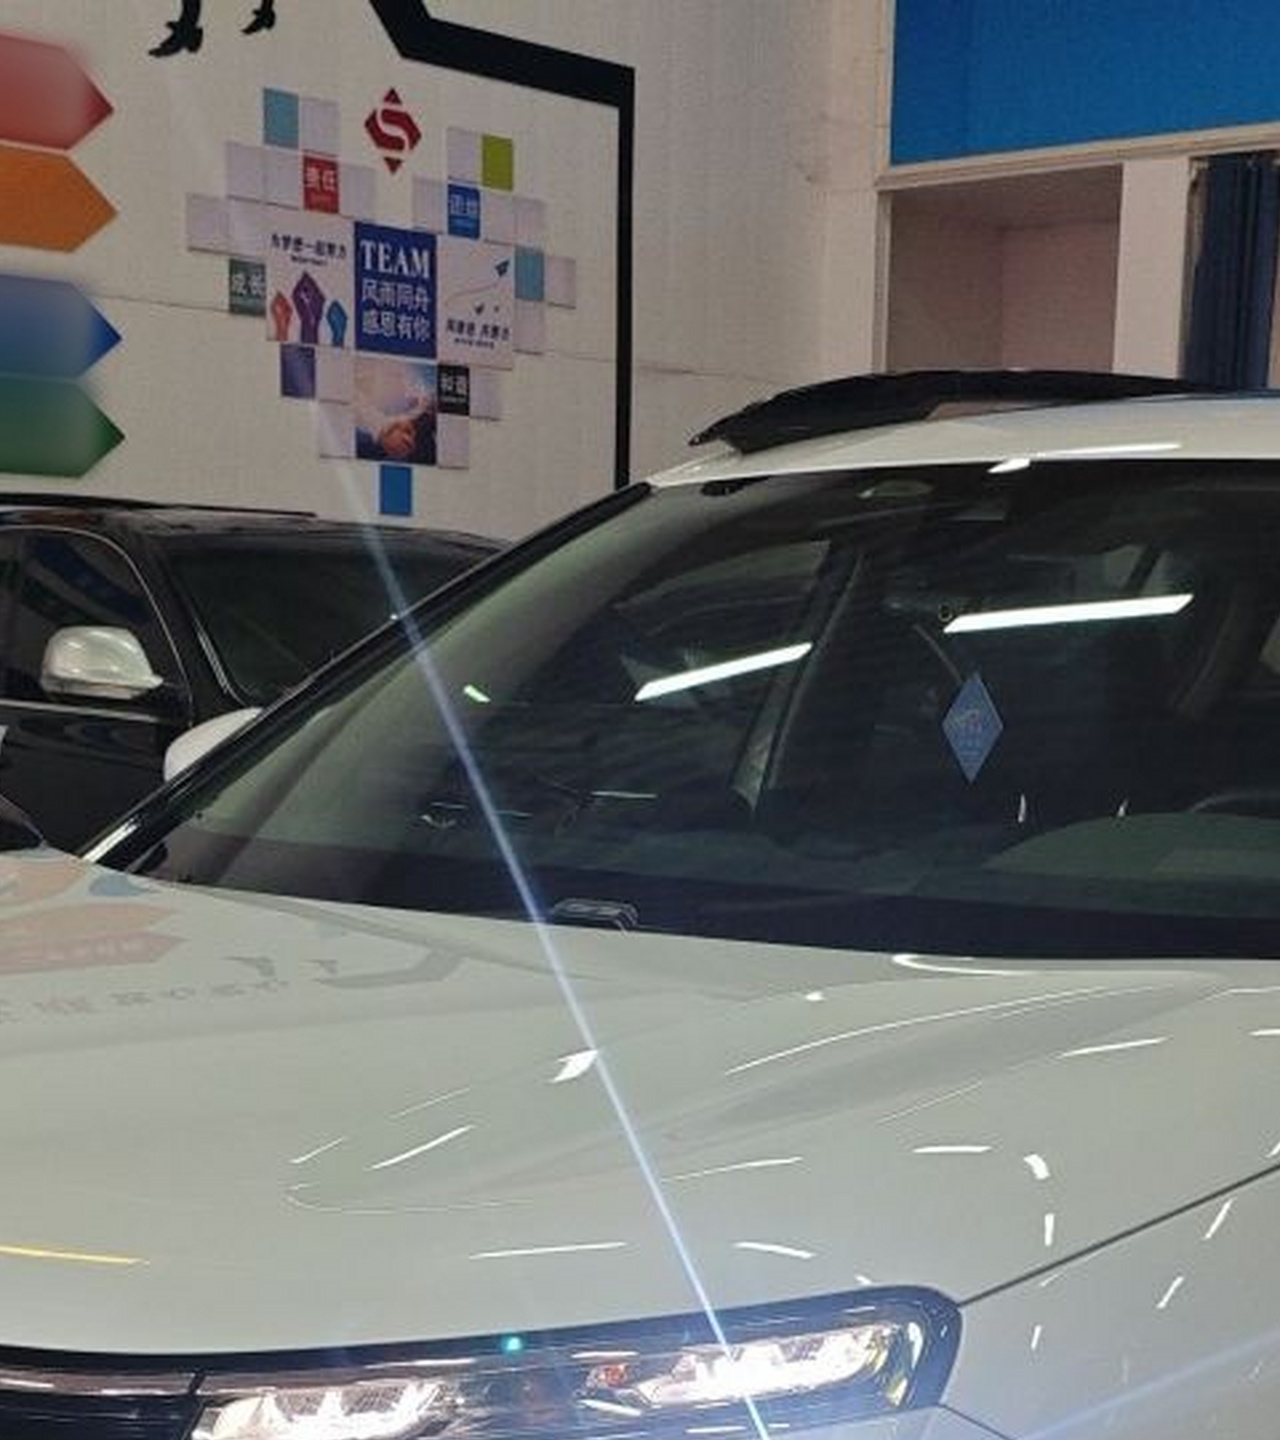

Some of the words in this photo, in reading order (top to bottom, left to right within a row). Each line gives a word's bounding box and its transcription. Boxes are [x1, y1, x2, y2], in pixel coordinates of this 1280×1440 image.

[359, 240, 430, 279] TEAM
[362, 278, 428, 313] 风雨同舟
[362, 308, 431, 343] 感恩有你
